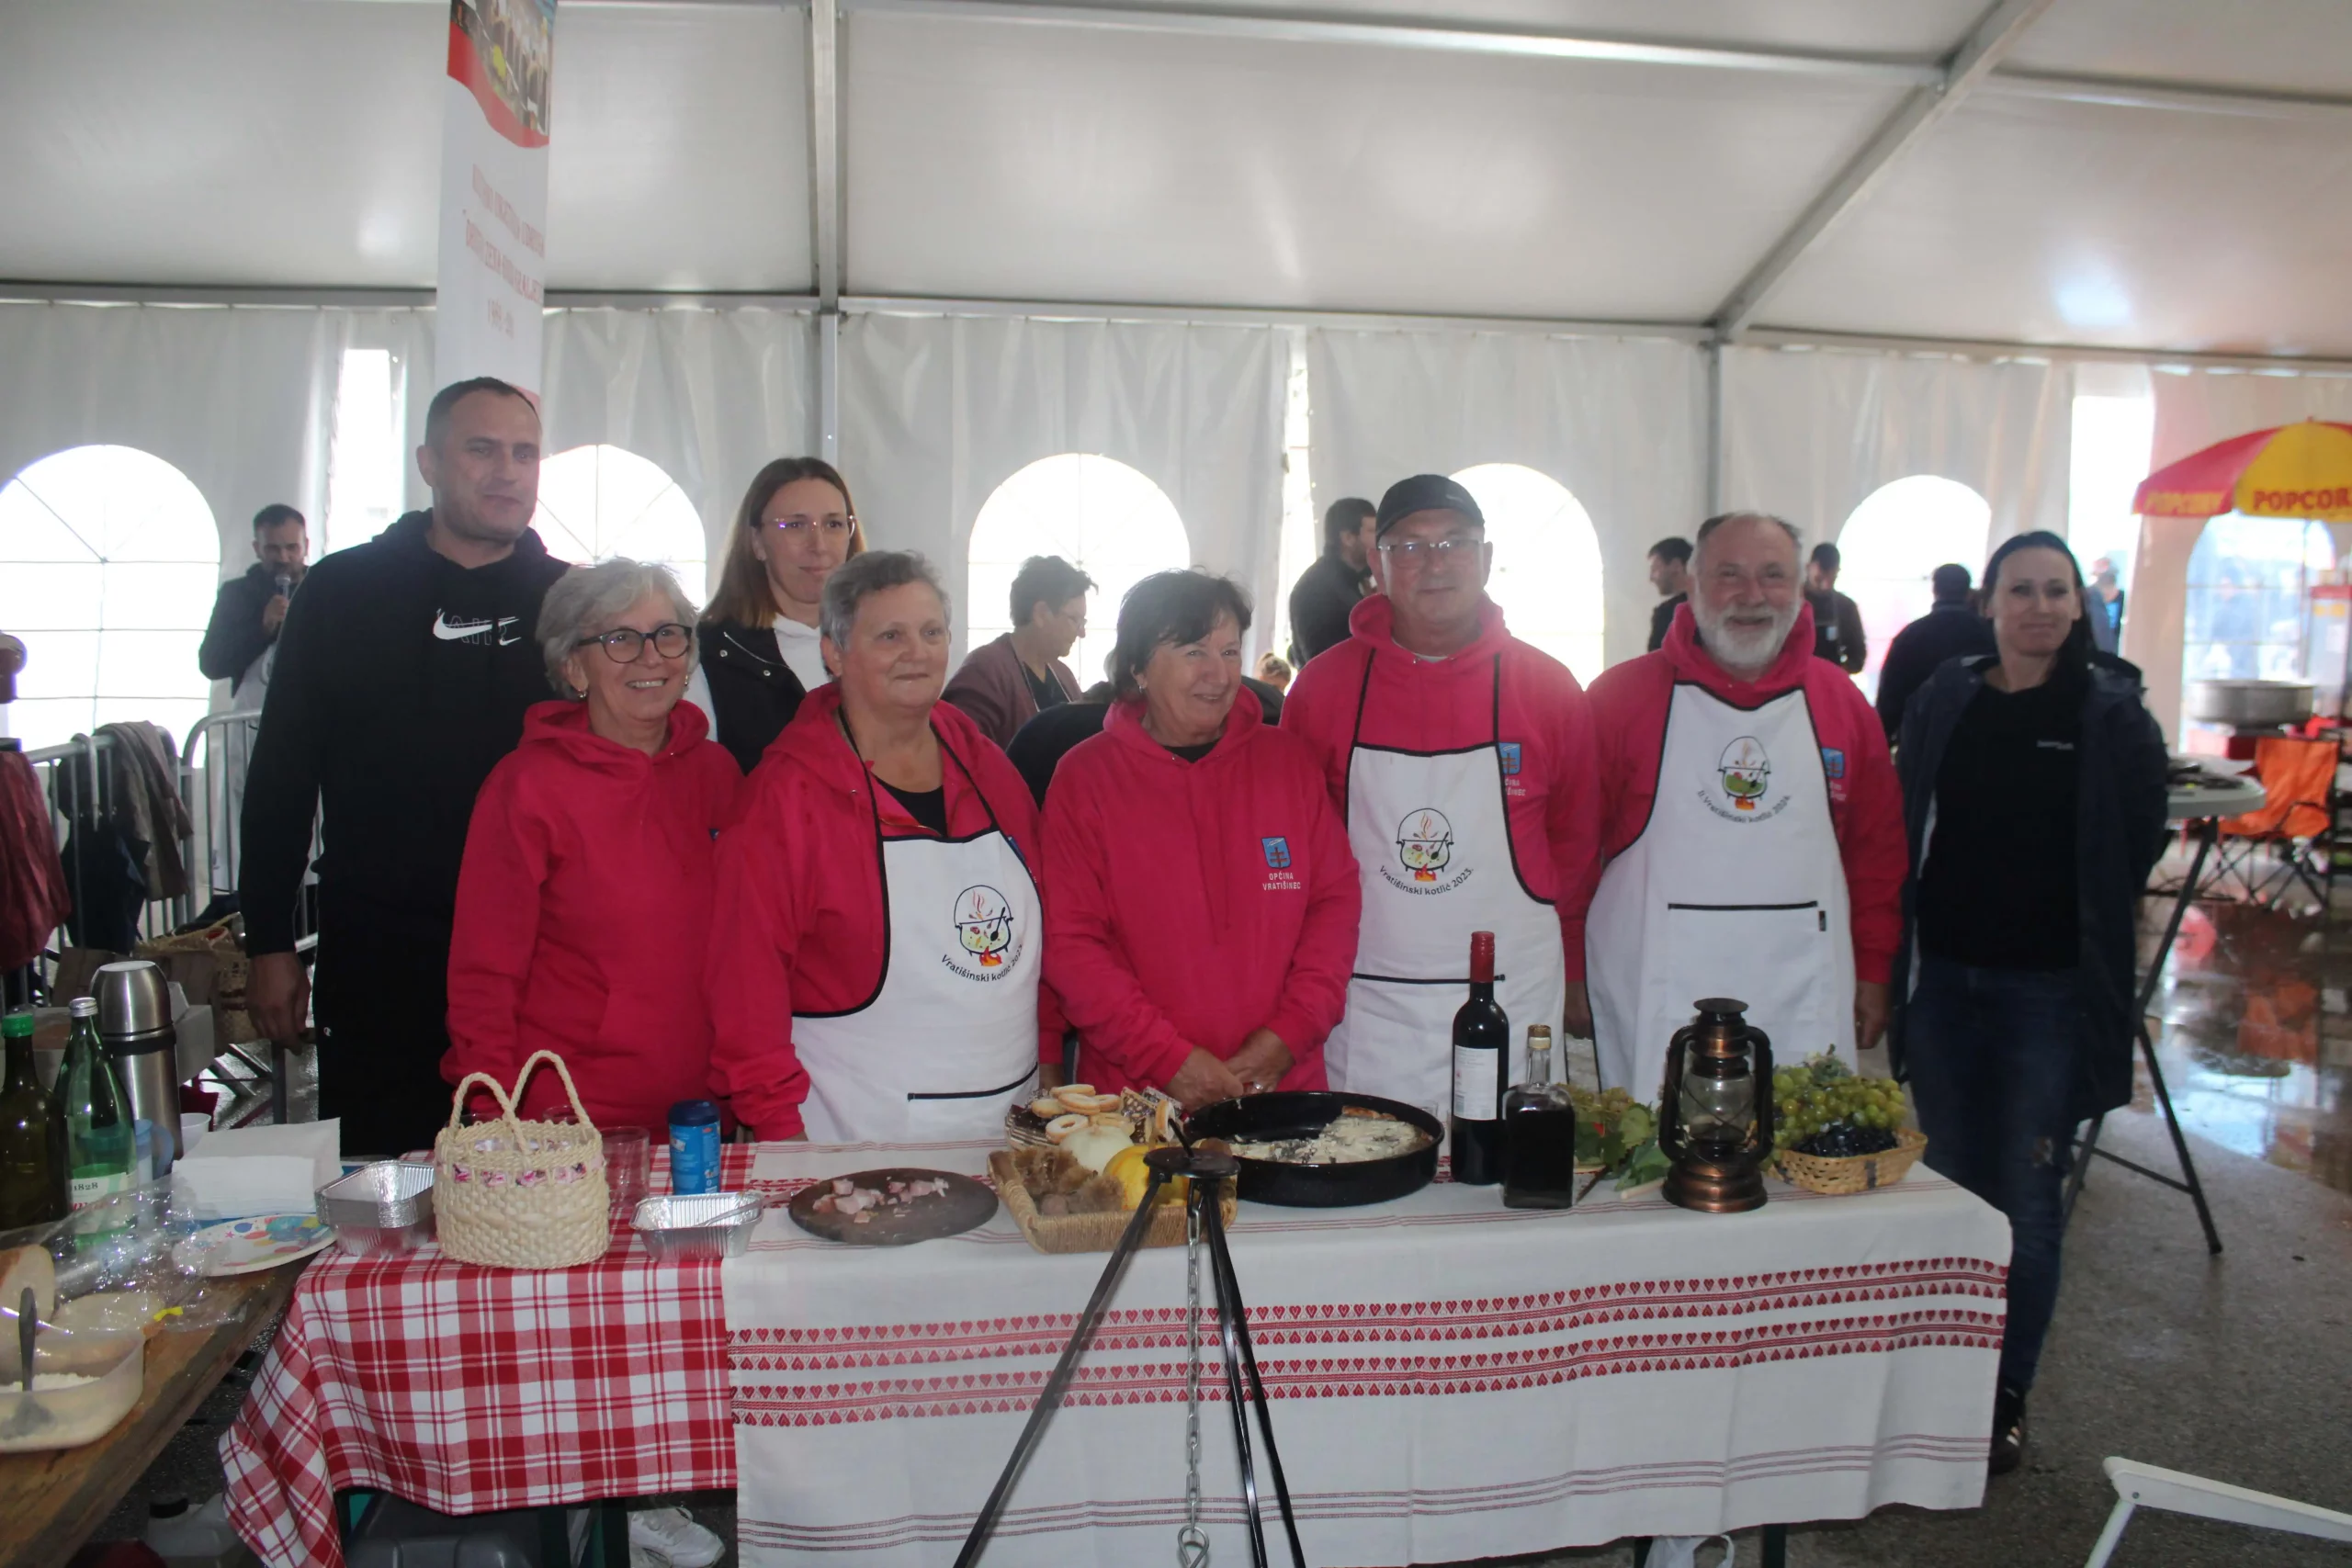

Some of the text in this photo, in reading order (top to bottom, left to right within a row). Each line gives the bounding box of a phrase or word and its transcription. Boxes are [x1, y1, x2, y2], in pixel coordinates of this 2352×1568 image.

[1262, 880, 1301, 891] VRATIŠINEC
[1380, 865, 1474, 896] Vratišinski kotlić 2023.
[941, 953, 989, 982] Vratišinski
[74, 1182, 98, 1191] 1828
